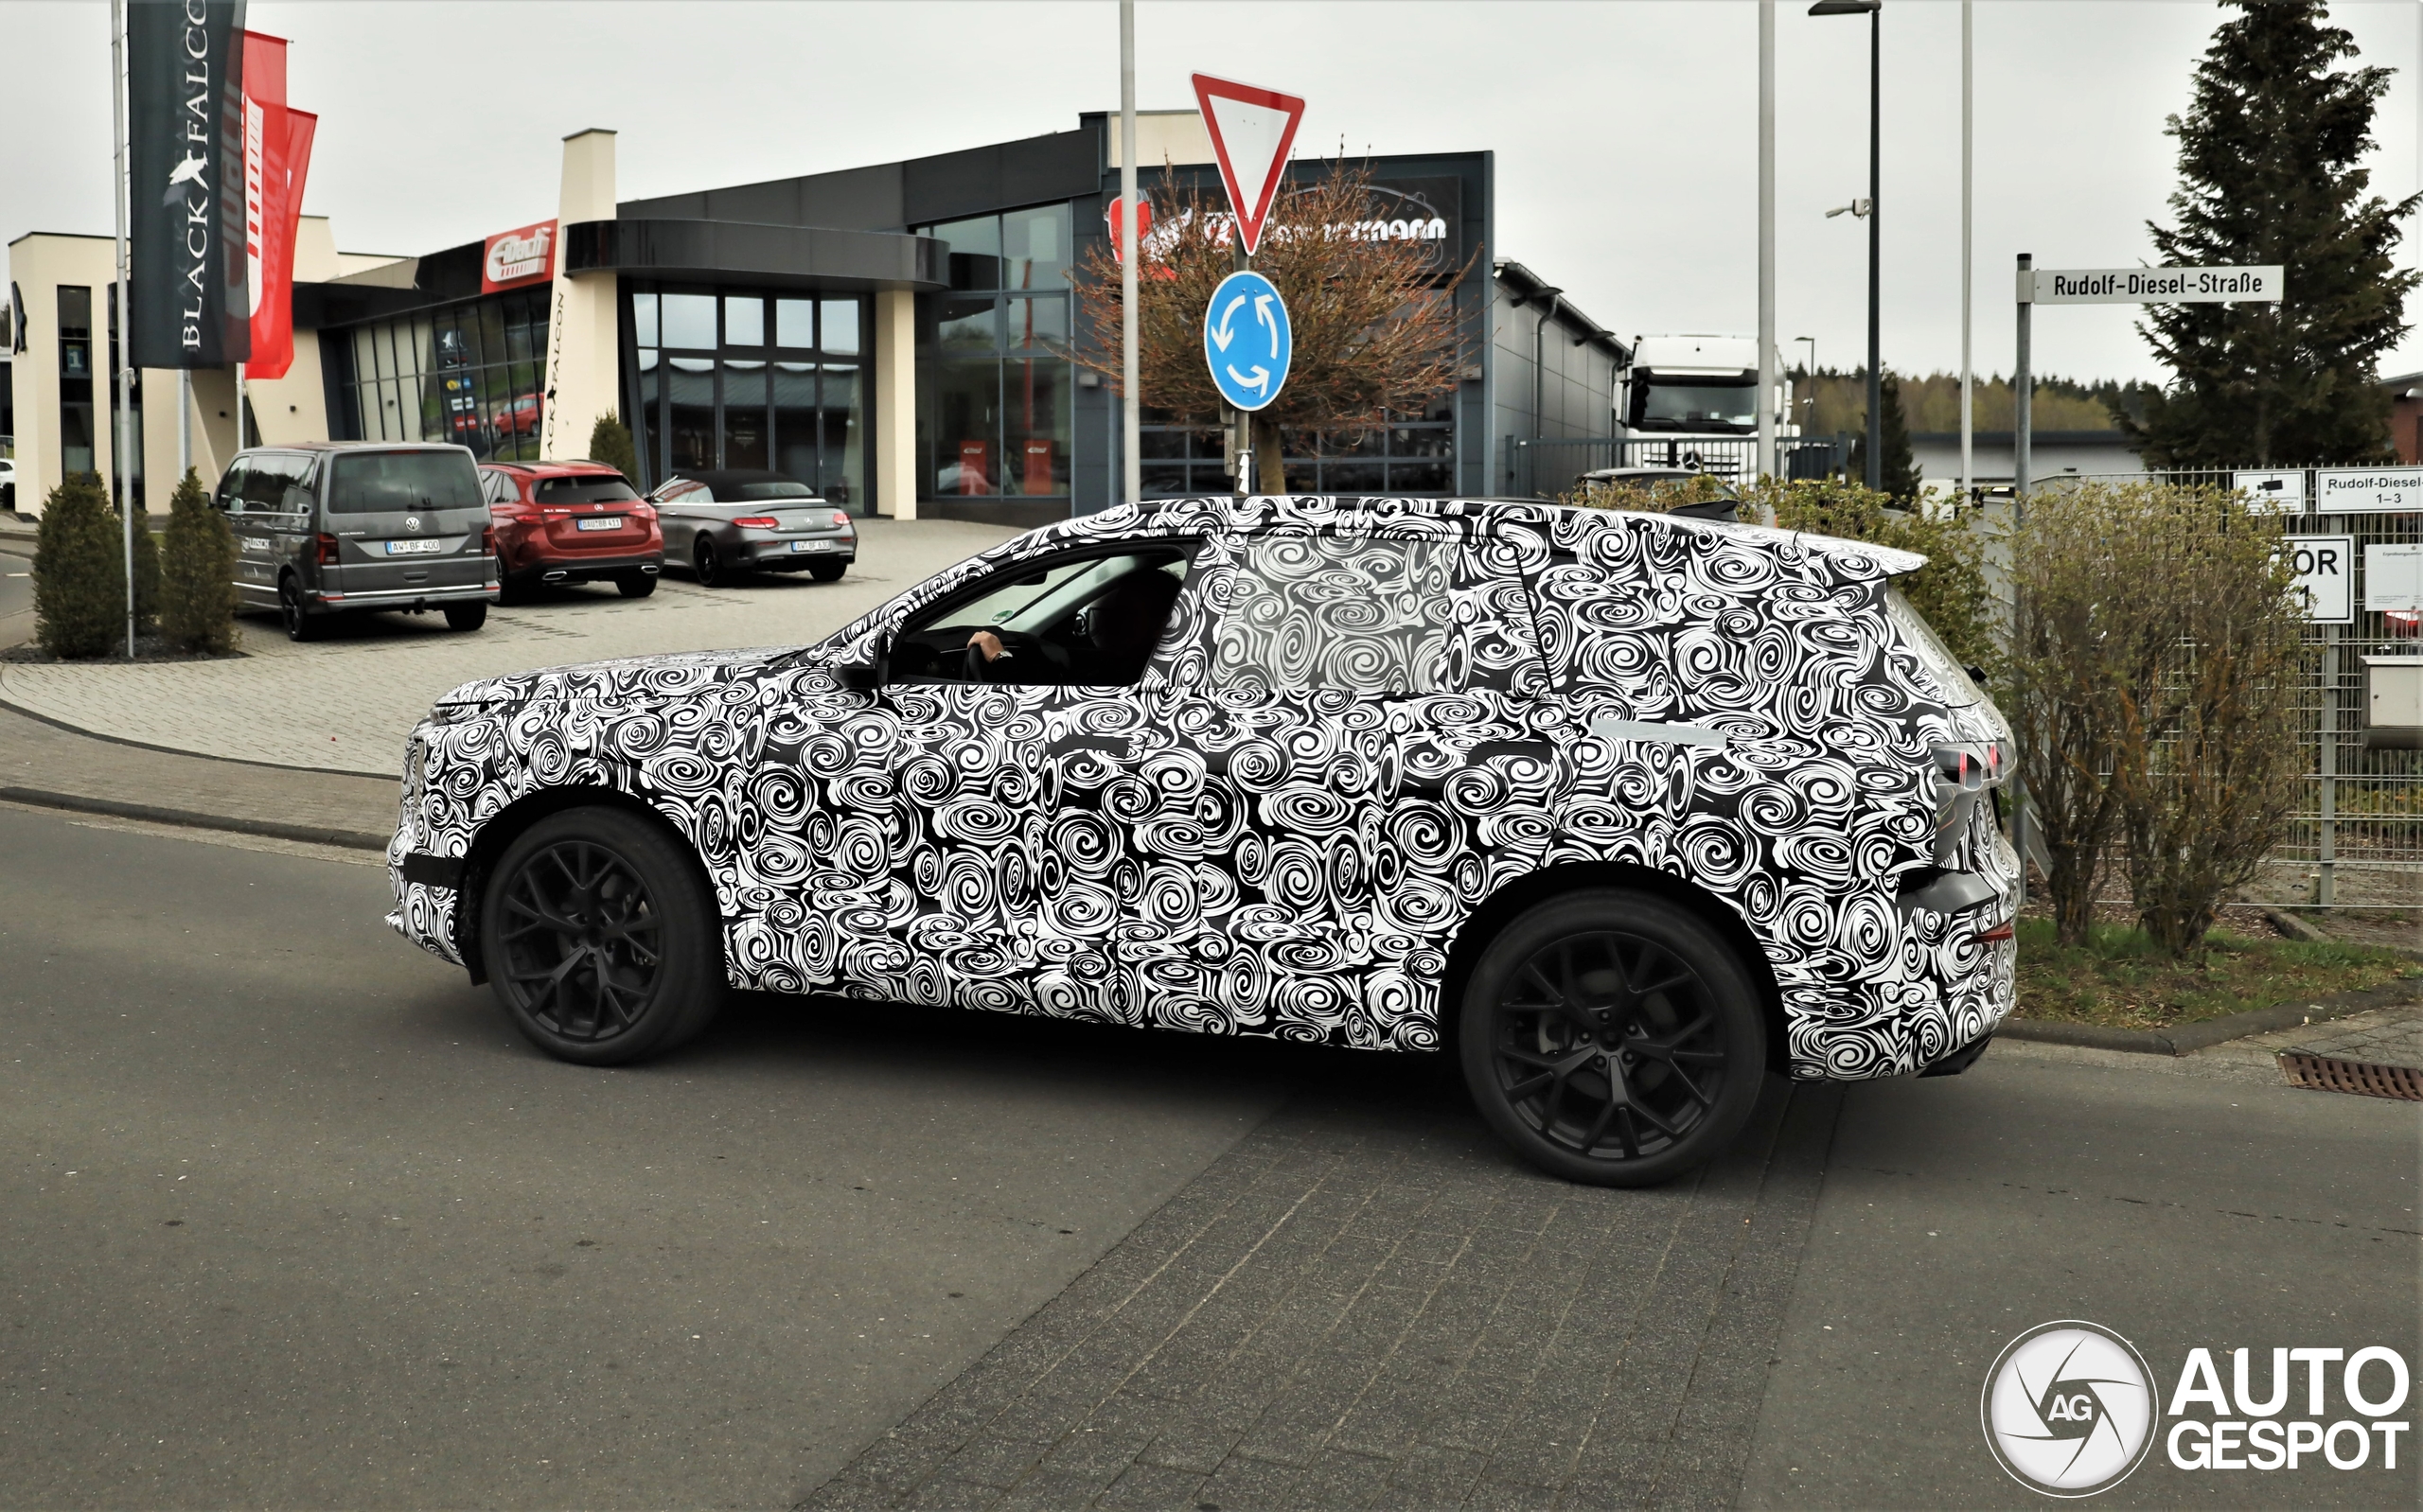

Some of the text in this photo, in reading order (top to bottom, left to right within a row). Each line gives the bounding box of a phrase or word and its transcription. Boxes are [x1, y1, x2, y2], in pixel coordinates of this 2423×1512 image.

[183, 197, 208, 348] BLACK
[2054, 272, 2263, 296] Rudolf-Diesel-Straße
[547, 291, 564, 461] ACK FALCON
[609, 519, 620, 527] 411
[393, 540, 439, 551] AW BF 400
[2271, 549, 2338, 575] OR
[2299, 585, 2309, 610] 1
